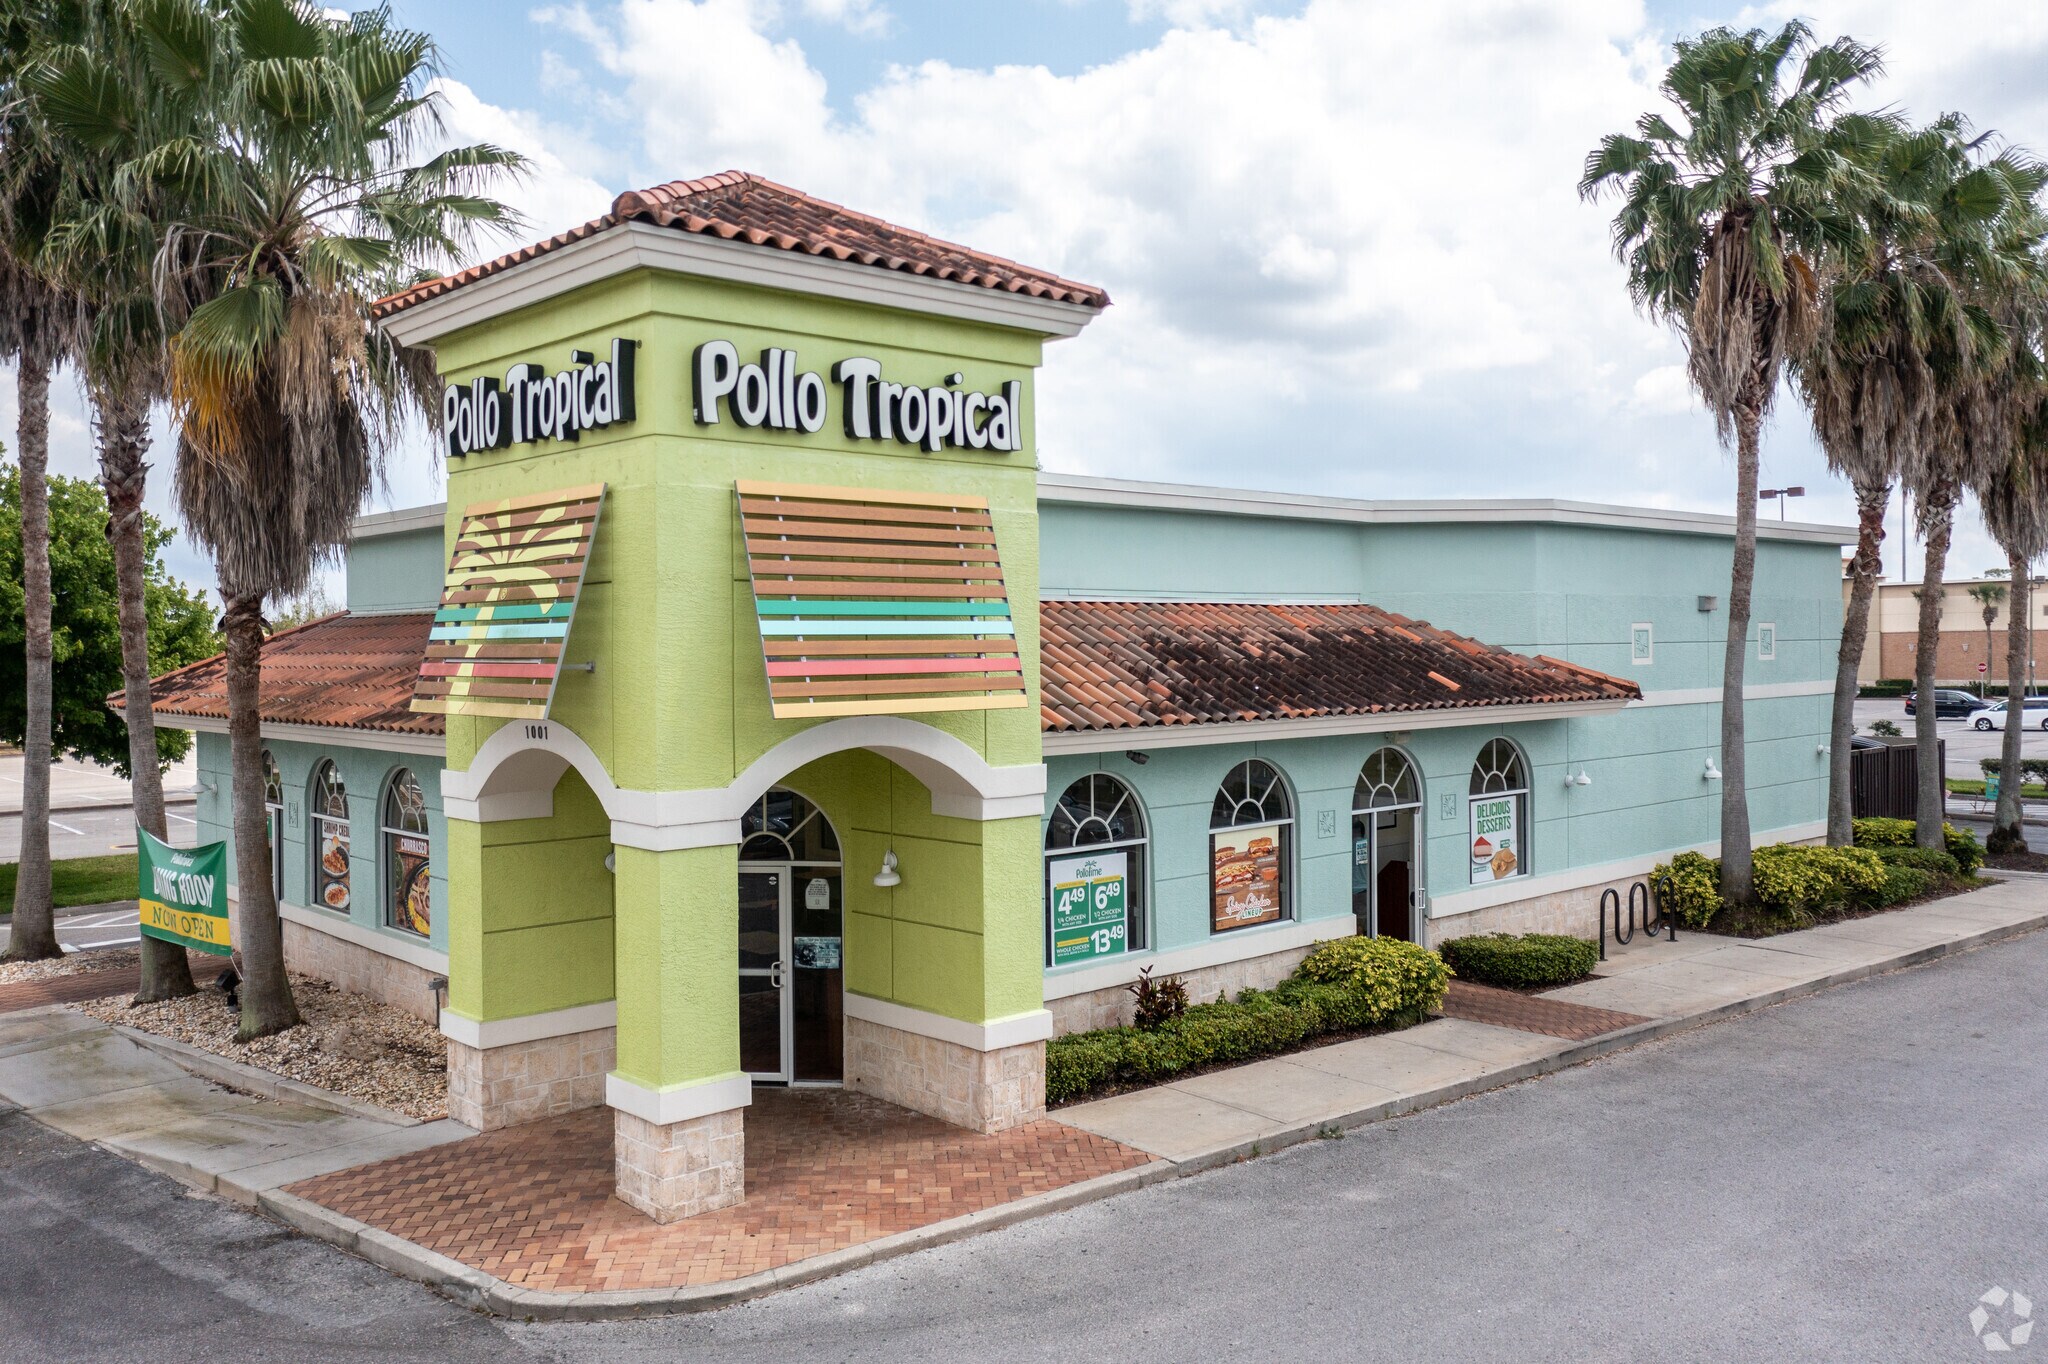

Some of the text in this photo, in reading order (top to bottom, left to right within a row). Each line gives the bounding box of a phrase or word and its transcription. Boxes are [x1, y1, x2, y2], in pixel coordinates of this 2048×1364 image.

[444, 337, 622, 457] Pollo Tropical
[694, 339, 1023, 452] Pollo Tropical
[525, 725, 548, 740] 1001
[1476, 800, 1511, 819] DELICIOUS
[1477, 815, 1512, 835] DESSERTS
[401, 837, 428, 855] CHURRASCO
[181, 916, 214, 940] OPEN
